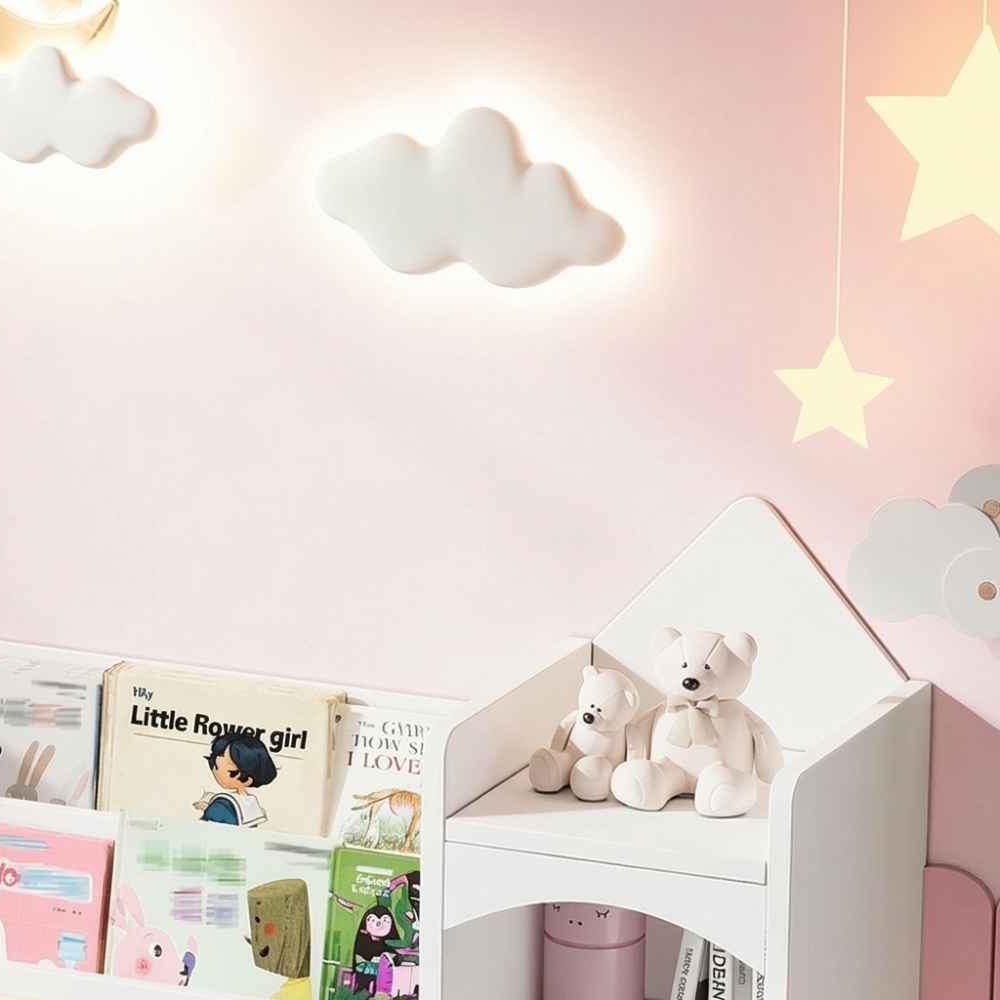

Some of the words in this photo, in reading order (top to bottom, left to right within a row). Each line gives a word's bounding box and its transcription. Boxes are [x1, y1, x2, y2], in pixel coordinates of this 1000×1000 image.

[130, 704, 188, 732] Little
[269, 727, 308, 753] girl
[363, 752, 421, 775] LOVE
